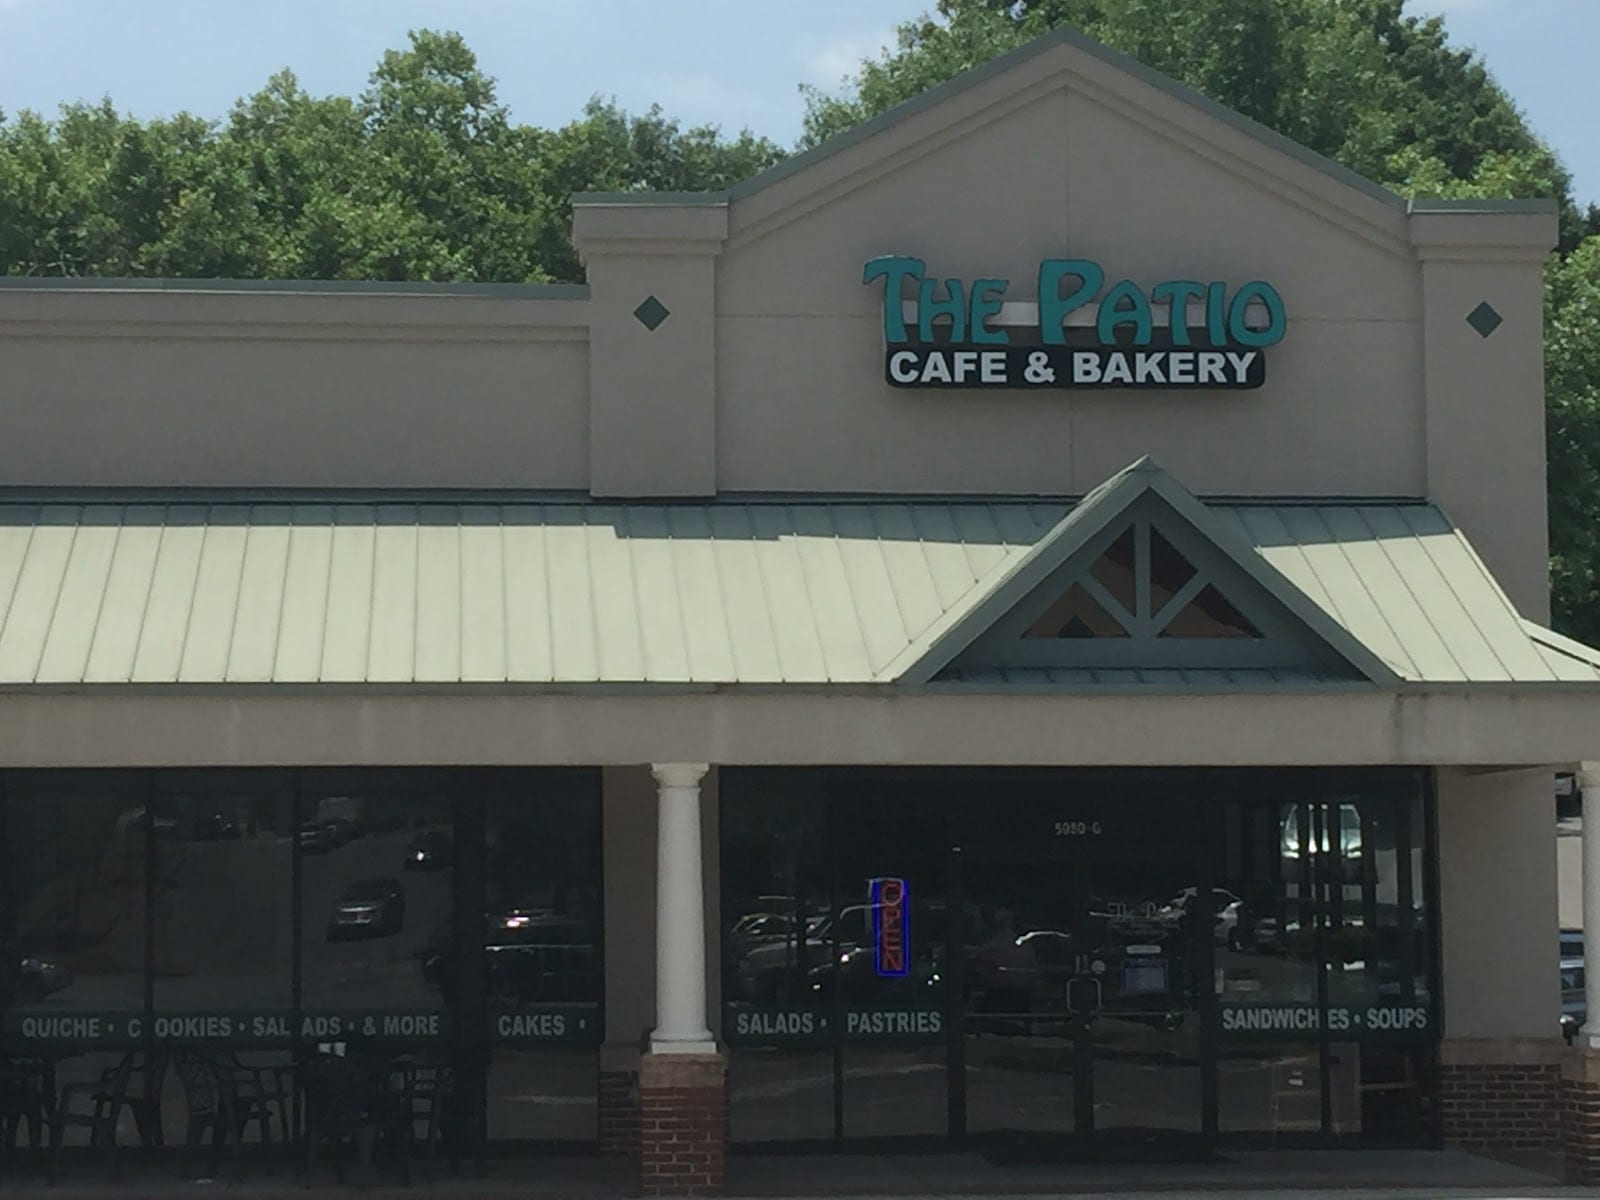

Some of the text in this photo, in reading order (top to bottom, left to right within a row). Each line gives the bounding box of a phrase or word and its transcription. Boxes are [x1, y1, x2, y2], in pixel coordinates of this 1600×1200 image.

[862, 254, 1287, 347] THE PATIO
[889, 350, 1257, 384] CAFE & BAKERY
[880, 881, 905, 972] OPEN
[21, 1017, 101, 1039] QUICHE
[362, 1015, 377, 1036] &
[384, 1014, 439, 1036] MORE
[497, 1014, 566, 1037] CAKES
[736, 1011, 814, 1035] SALADS
[846, 1010, 942, 1034] PASTRIES
[1366, 1007, 1427, 1030] SOUPS
